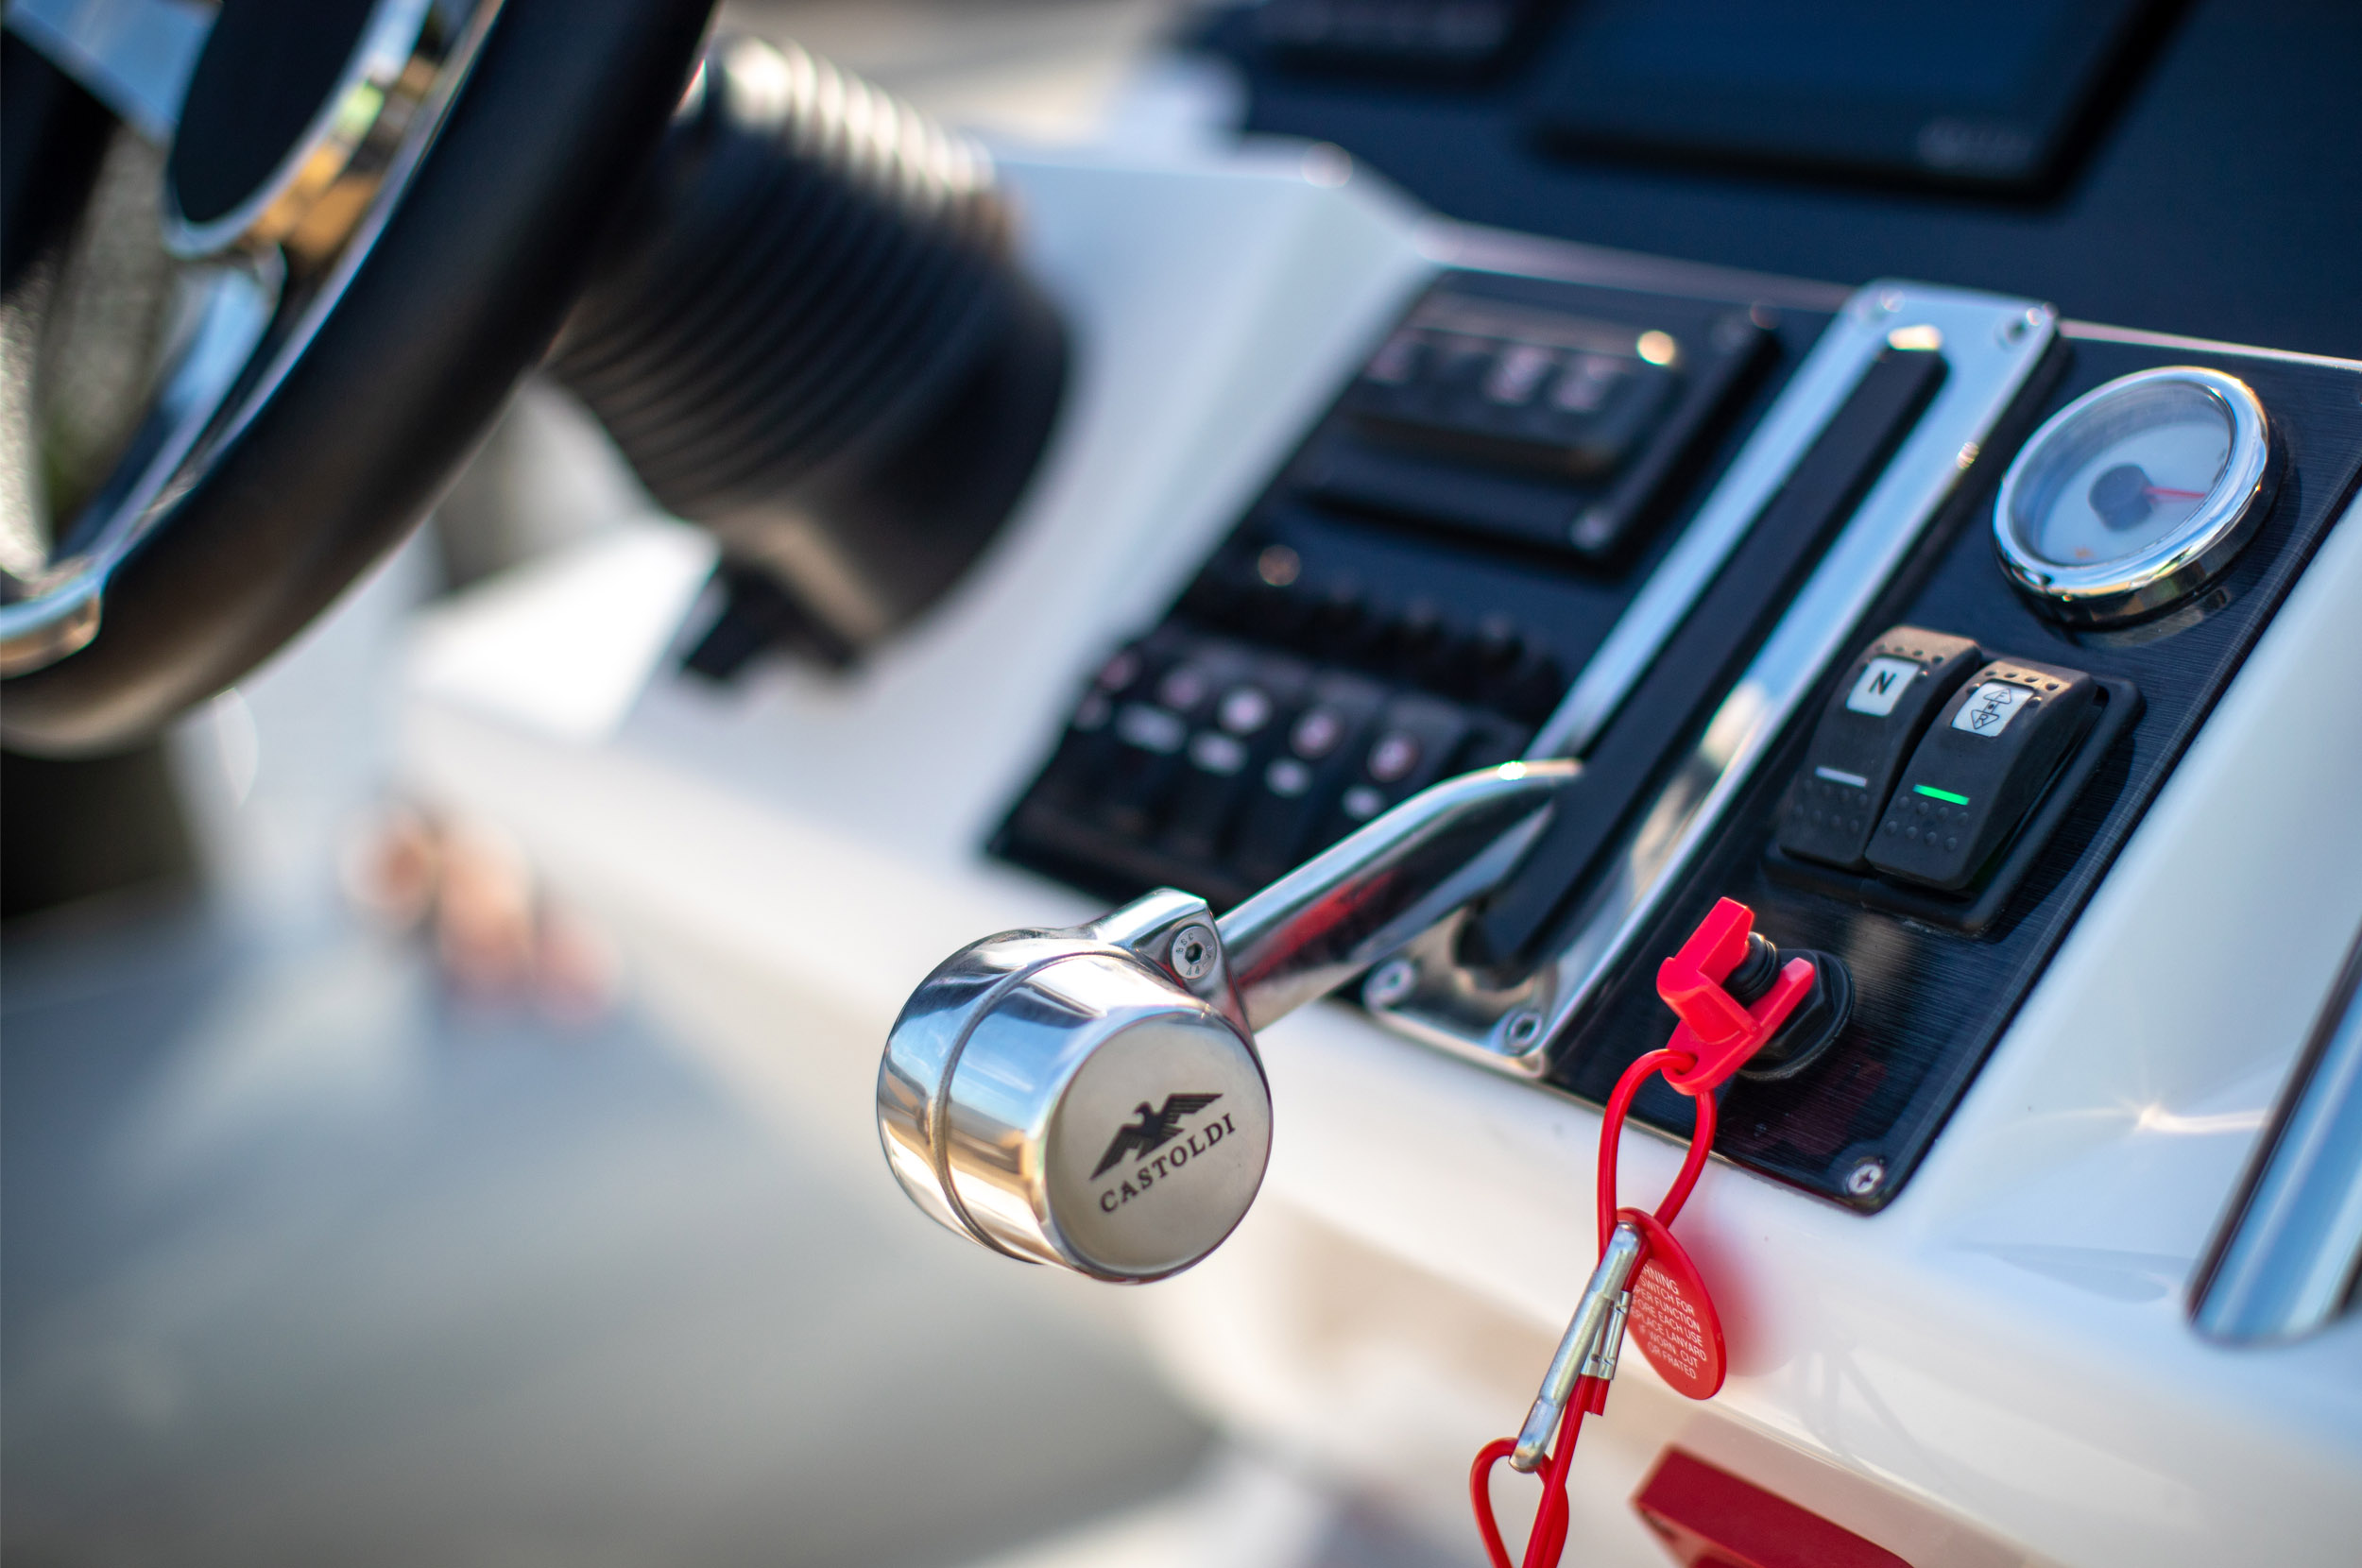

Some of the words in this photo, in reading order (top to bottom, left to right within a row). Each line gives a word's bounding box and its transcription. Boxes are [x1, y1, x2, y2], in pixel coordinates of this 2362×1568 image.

[1869, 670, 1897, 695] N
[1975, 713, 1989, 726] R
[1100, 1113, 1236, 1213] CASTOLDI
[1639, 1275, 1674, 1304] SWITCH
[1676, 1297, 1696, 1317] FOR
[1642, 1264, 1680, 1295] RNING
[1632, 1296, 1657, 1319] FORE
[1658, 1311, 1684, 1335] EACH
[1684, 1327, 1703, 1348] USE
[1633, 1285, 1652, 1304] PER
[1654, 1296, 1701, 1333] FUNCTION
[1629, 1306, 1664, 1335] EPLACE
[1666, 1328, 1708, 1362] LANYARD
[1680, 1350, 1699, 1368] CUT
